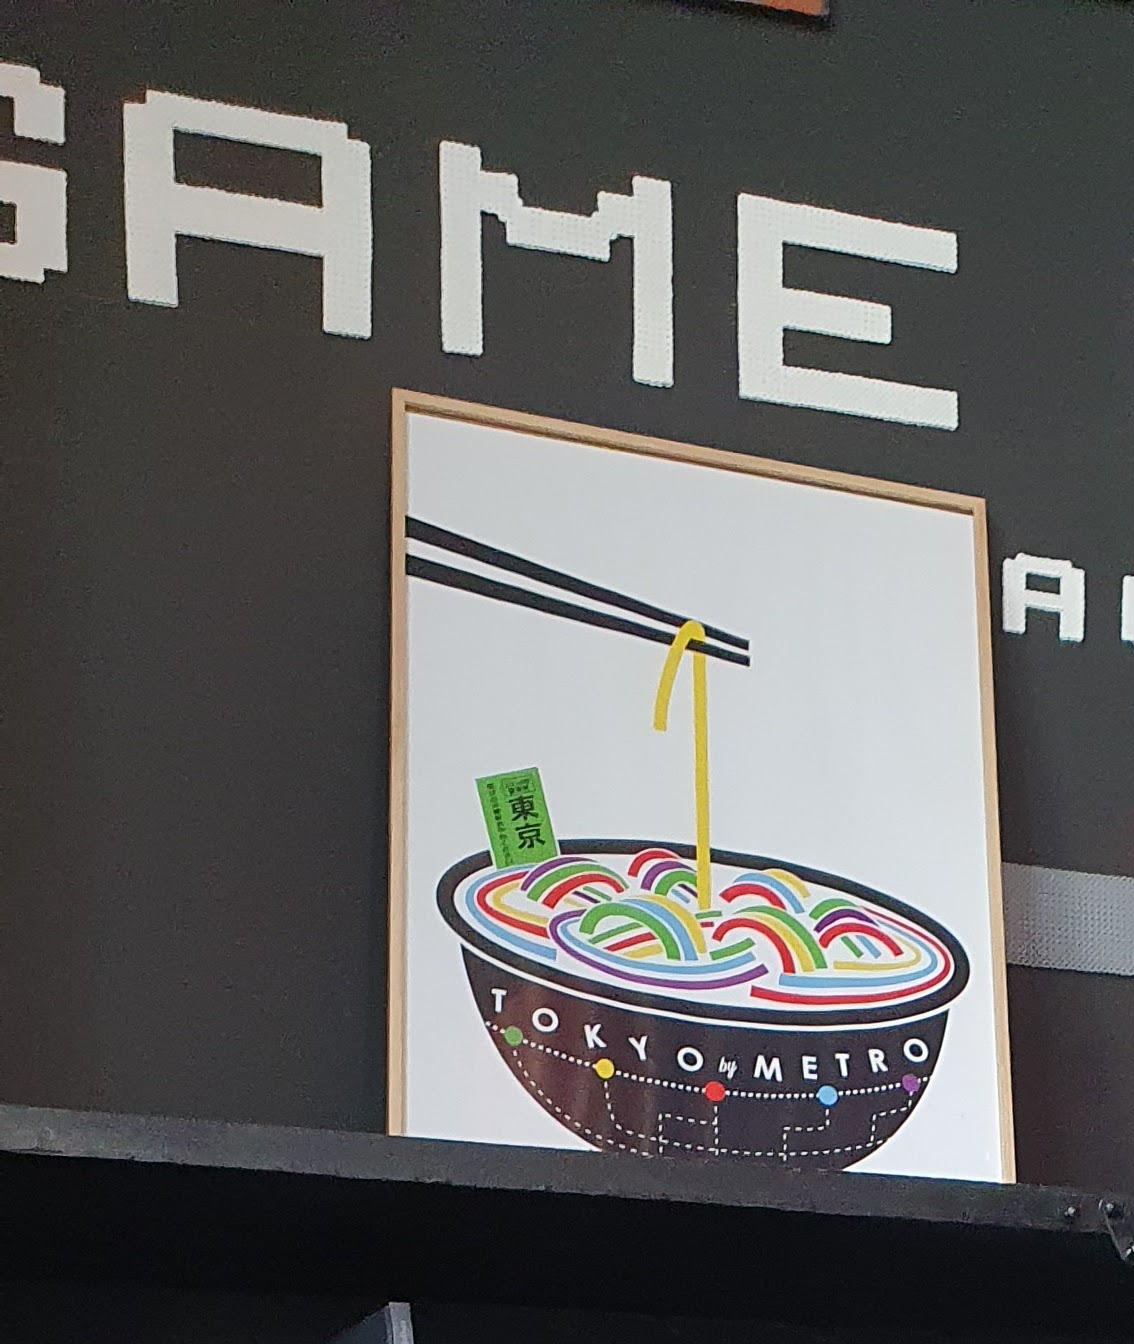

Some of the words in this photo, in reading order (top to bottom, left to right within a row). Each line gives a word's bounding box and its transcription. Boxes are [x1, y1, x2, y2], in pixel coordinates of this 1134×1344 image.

[0, 62, 958, 430] AME
[508, 794, 545, 849] 東京
[491, 988, 703, 1072] TOKYO
[718, 1056, 737, 1079] by
[753, 1039, 928, 1082] METRO
